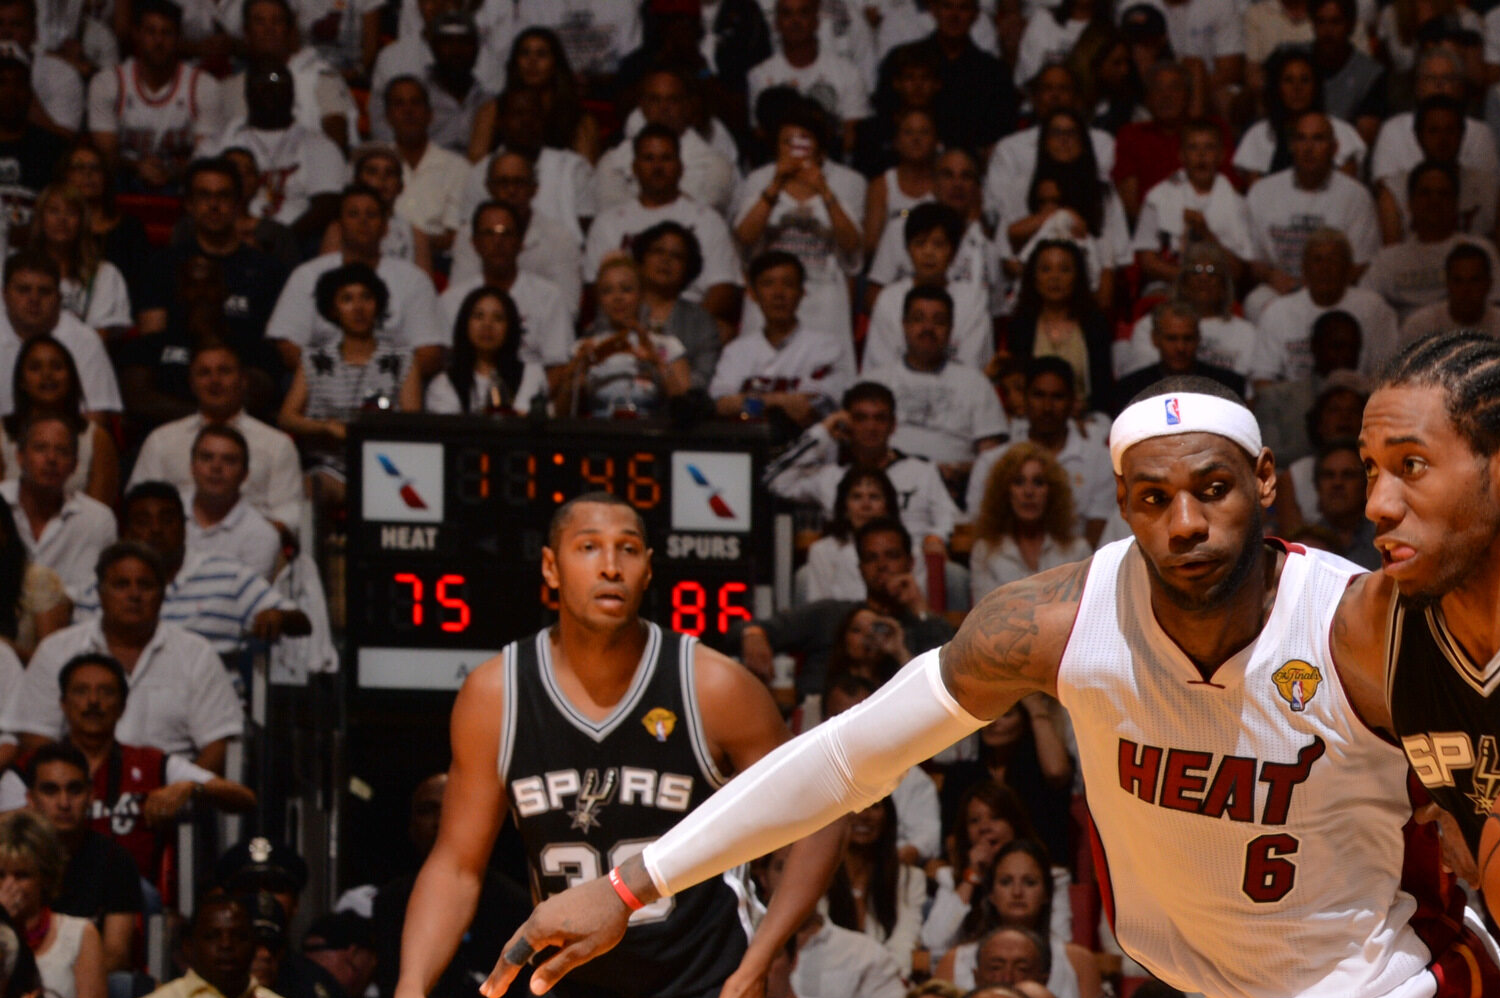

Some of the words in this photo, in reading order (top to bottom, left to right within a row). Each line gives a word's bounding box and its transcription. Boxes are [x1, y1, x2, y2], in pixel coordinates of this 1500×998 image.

[380, 526, 439, 550] HEAT
[666, 534, 742, 560] SPURS
[393, 572, 472, 633] 75
[671, 580, 753, 637] 86
[511, 765, 695, 820] SPURS
[1117, 733, 1327, 826] HEAT
[1242, 832, 1300, 904] 6
